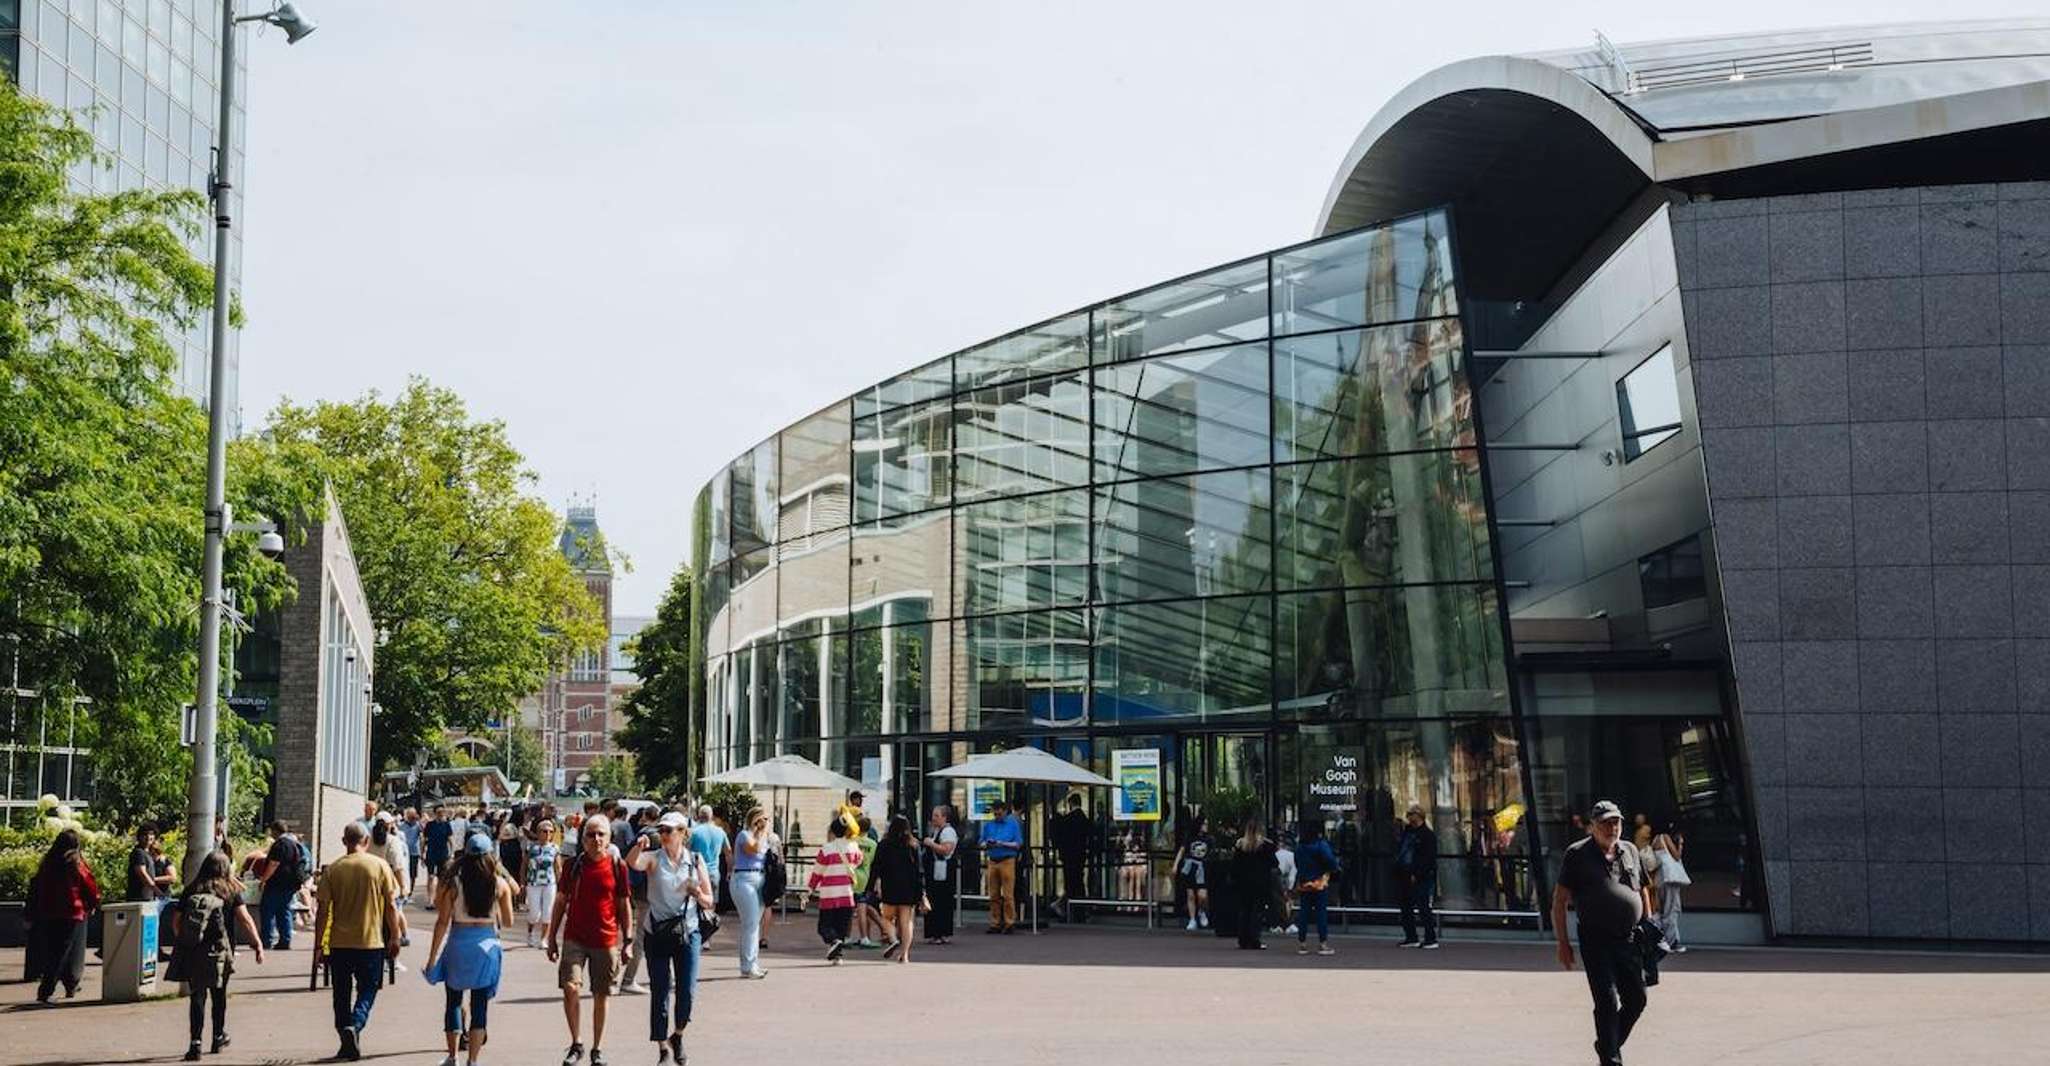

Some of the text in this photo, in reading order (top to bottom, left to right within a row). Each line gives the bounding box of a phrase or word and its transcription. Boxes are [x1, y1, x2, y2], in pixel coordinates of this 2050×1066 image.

[1333, 755, 1356, 768] Van
[1325, 769, 1357, 783] Gogh
[1309, 783, 1357, 795] Museum
